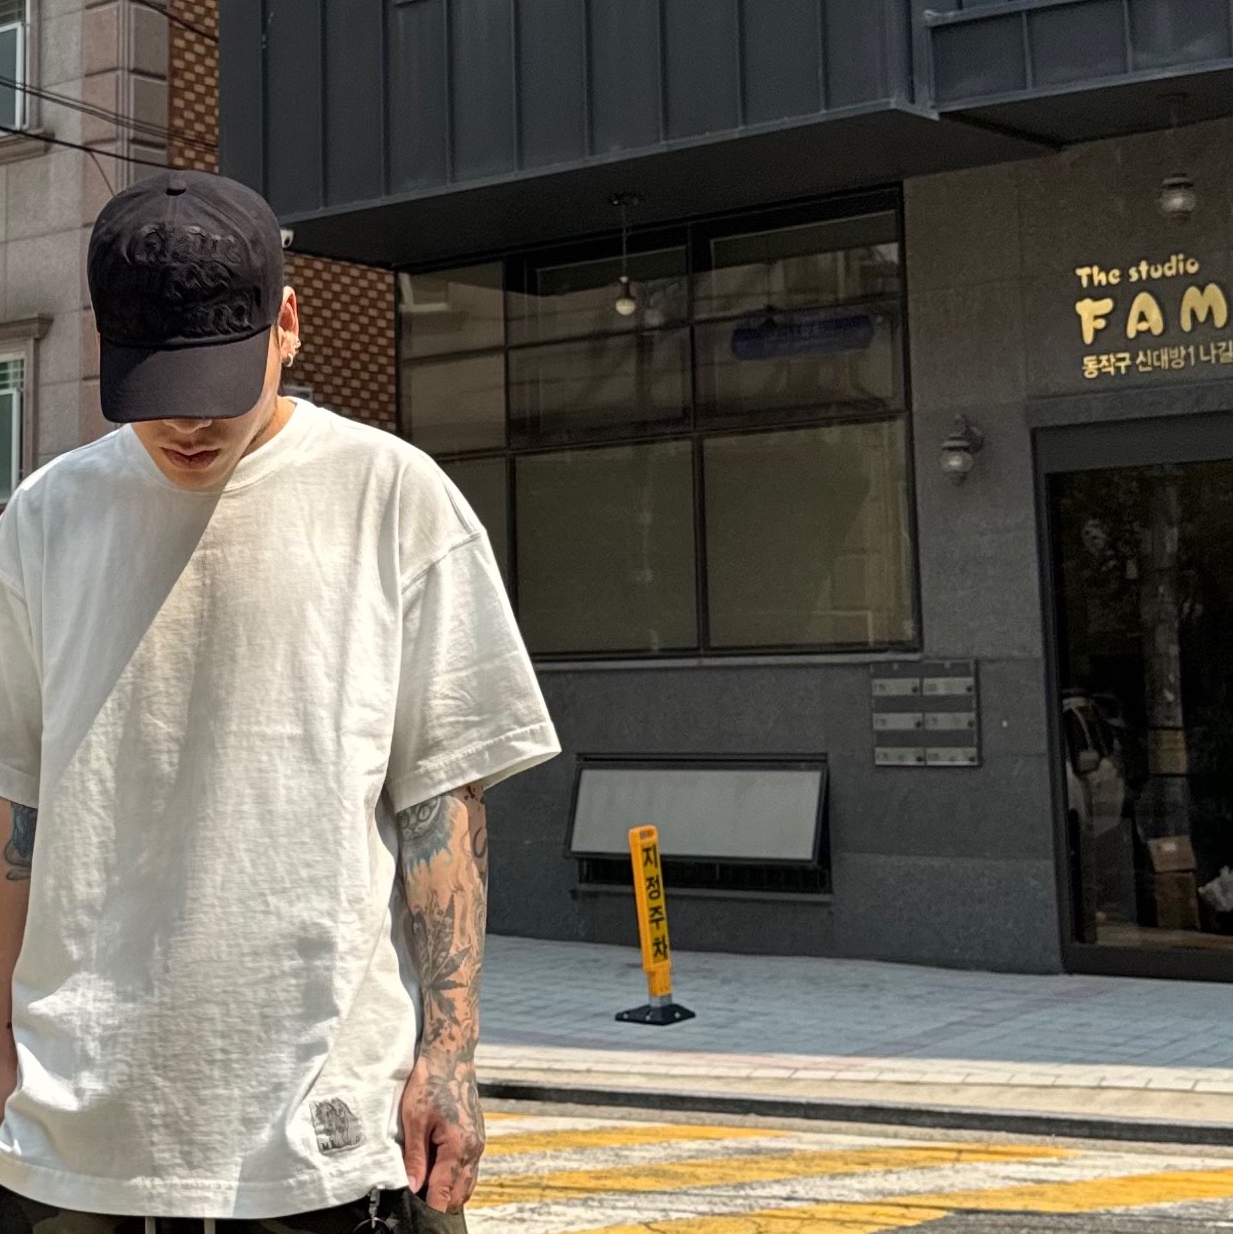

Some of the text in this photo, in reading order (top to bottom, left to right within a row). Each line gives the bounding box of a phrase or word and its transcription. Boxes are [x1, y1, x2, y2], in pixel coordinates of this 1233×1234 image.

[1075, 253, 1200, 288] The studio
[1075, 283, 1229, 345] FAM
[1082, 352, 1132, 379] 동작구
[642, 844, 669, 960] 지정주차
